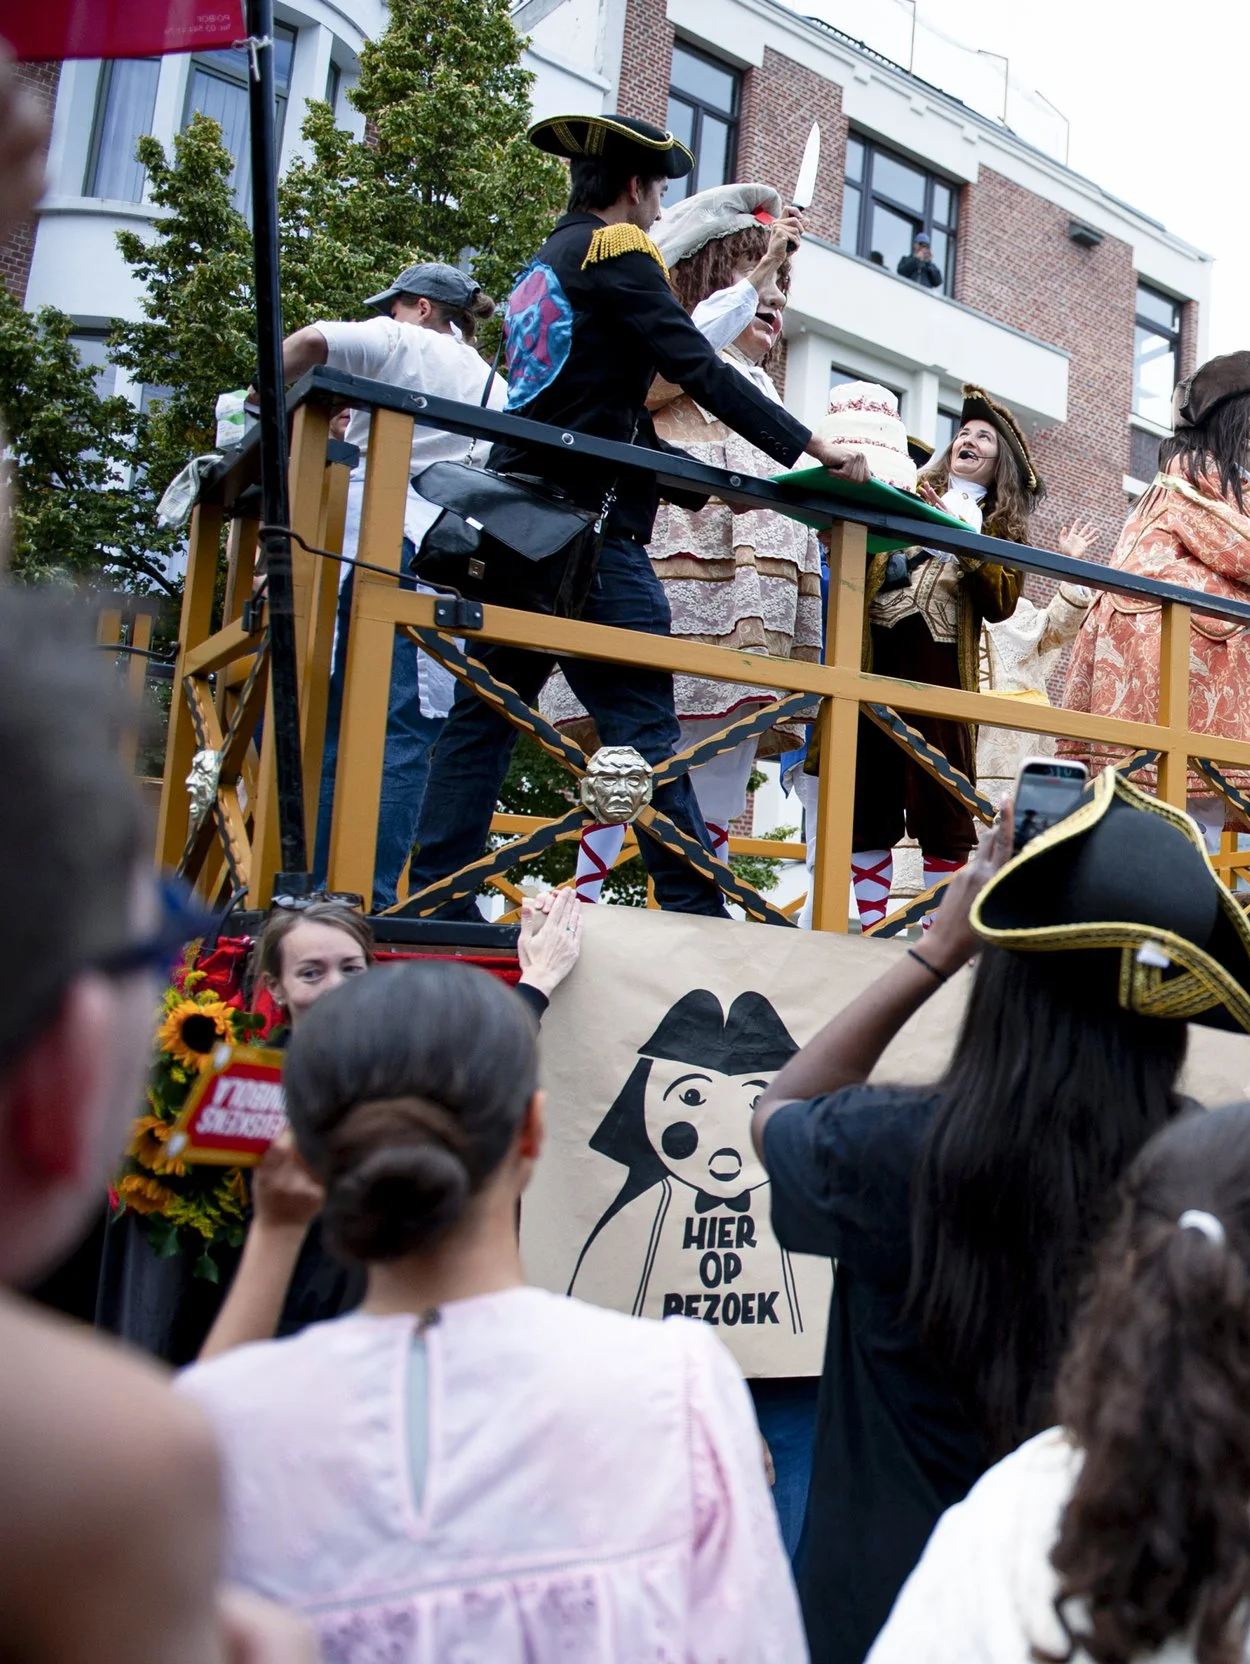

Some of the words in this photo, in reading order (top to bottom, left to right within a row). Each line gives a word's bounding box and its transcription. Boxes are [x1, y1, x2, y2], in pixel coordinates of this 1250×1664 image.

[682, 1215, 757, 1249] HIER
[699, 1251, 742, 1289] OP
[662, 1290, 781, 1327] BEZOEK
